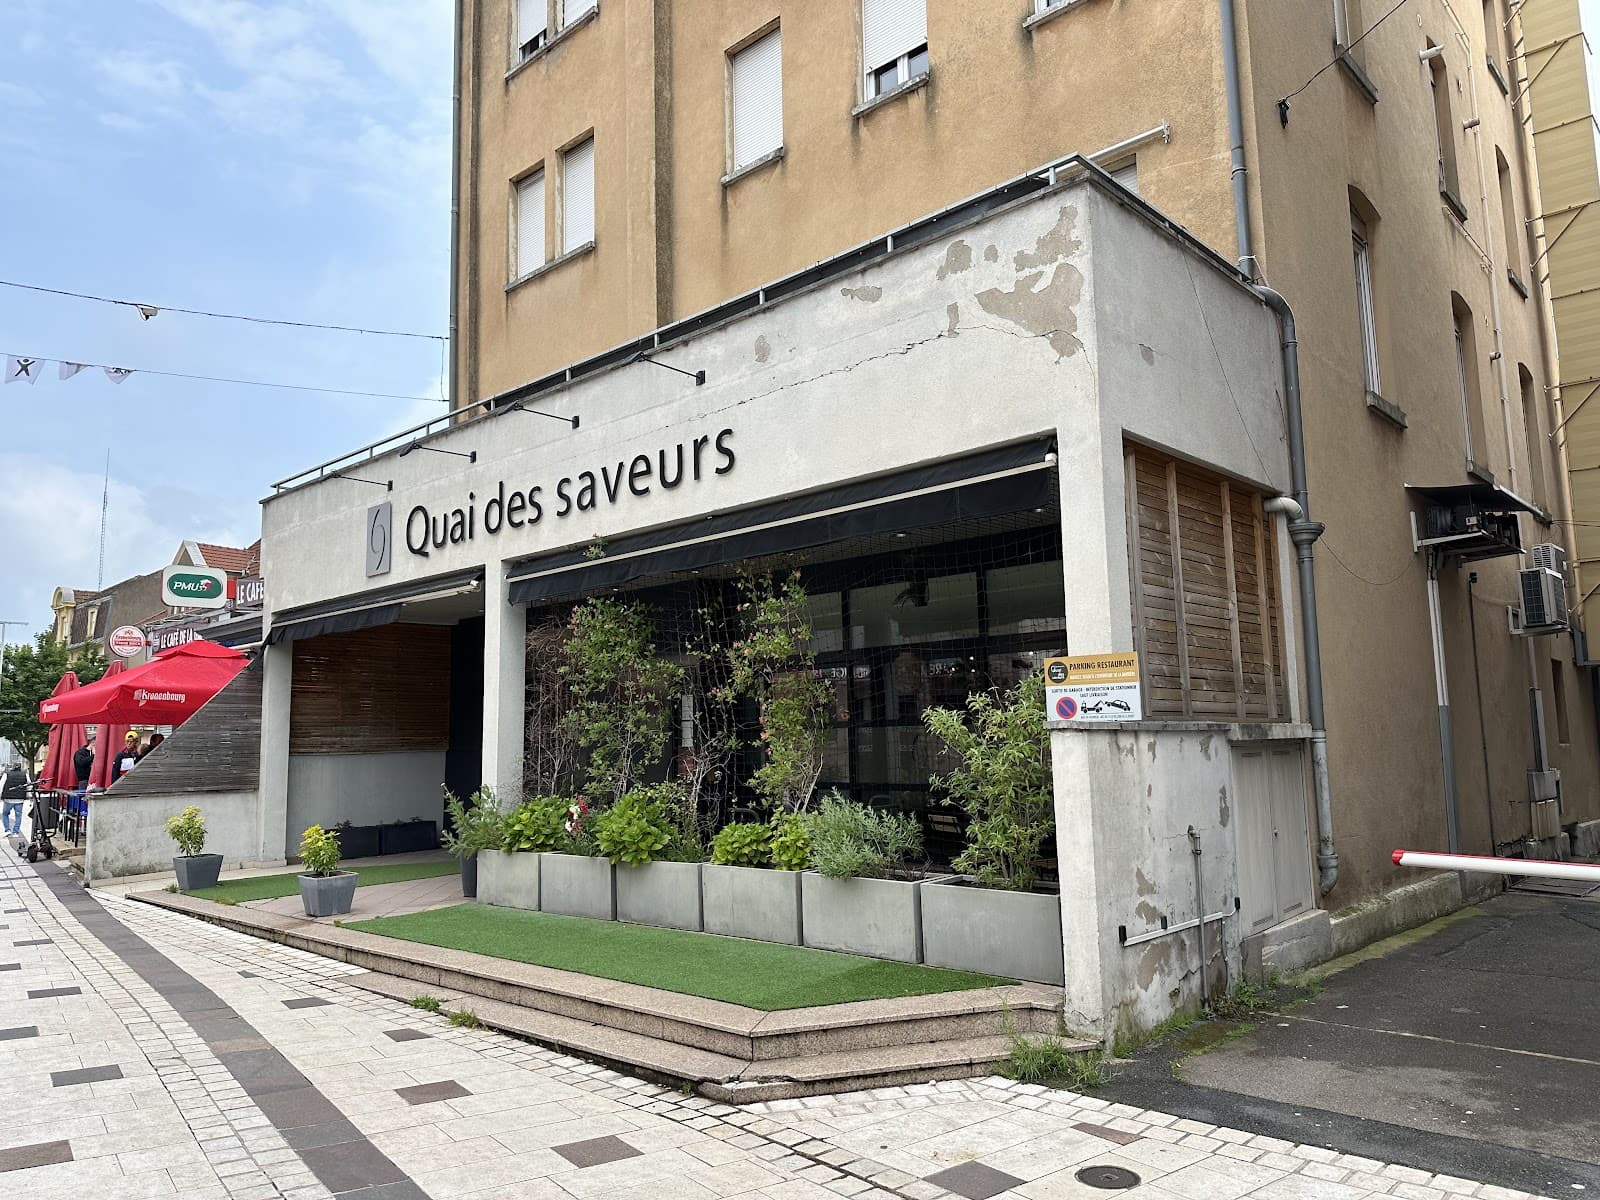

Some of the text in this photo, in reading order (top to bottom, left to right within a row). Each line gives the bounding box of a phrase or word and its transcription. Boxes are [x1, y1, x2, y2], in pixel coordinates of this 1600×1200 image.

[405, 428, 736, 559] Quai des saveurs
[173, 581, 200, 592] PMU
[236, 584, 245, 604] LE
[160, 634, 167, 649] LE
[1069, 659, 1135, 671] PARKING RESTAURANT
[142, 688, 186, 704] Kronenbourg
